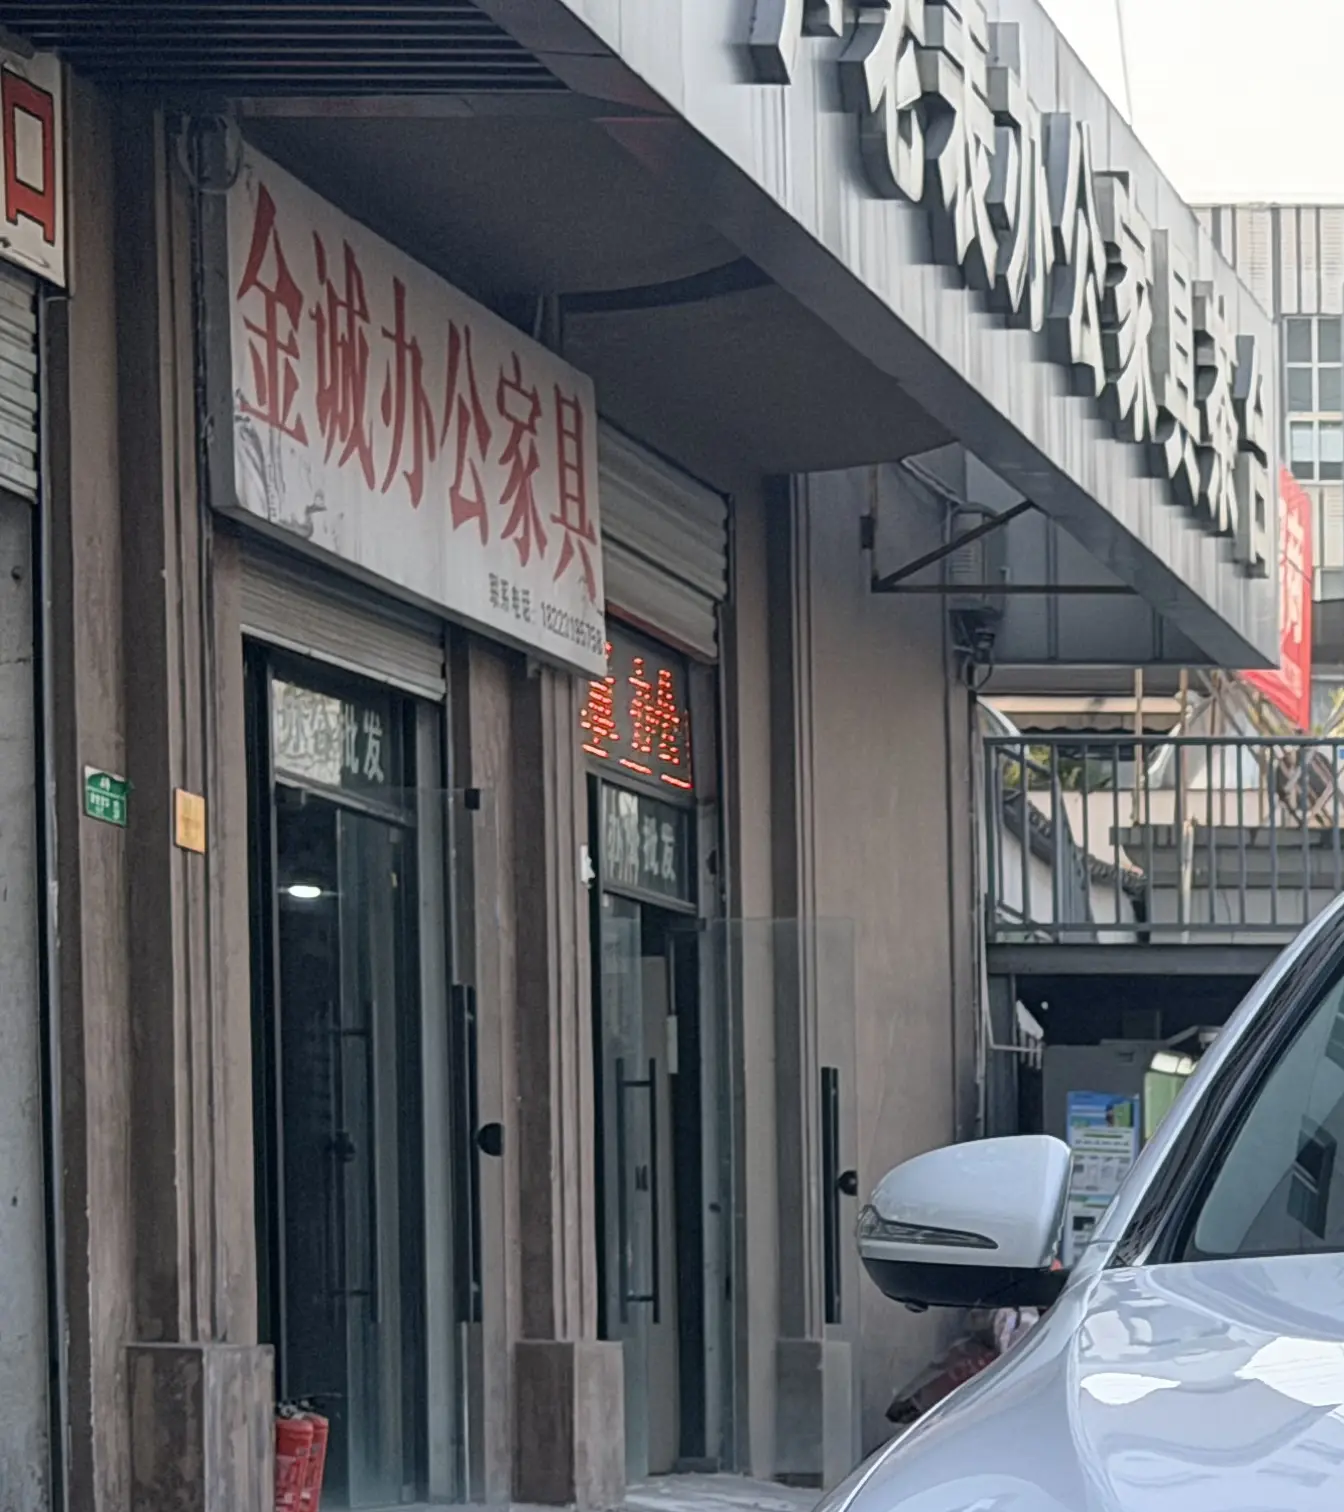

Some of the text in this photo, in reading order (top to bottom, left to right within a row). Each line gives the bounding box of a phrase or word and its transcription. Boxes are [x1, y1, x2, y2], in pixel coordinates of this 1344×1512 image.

[236, 182, 598, 602] 金诚办公家具
[774, 0, 1270, 565] 老表办公家具茶台
